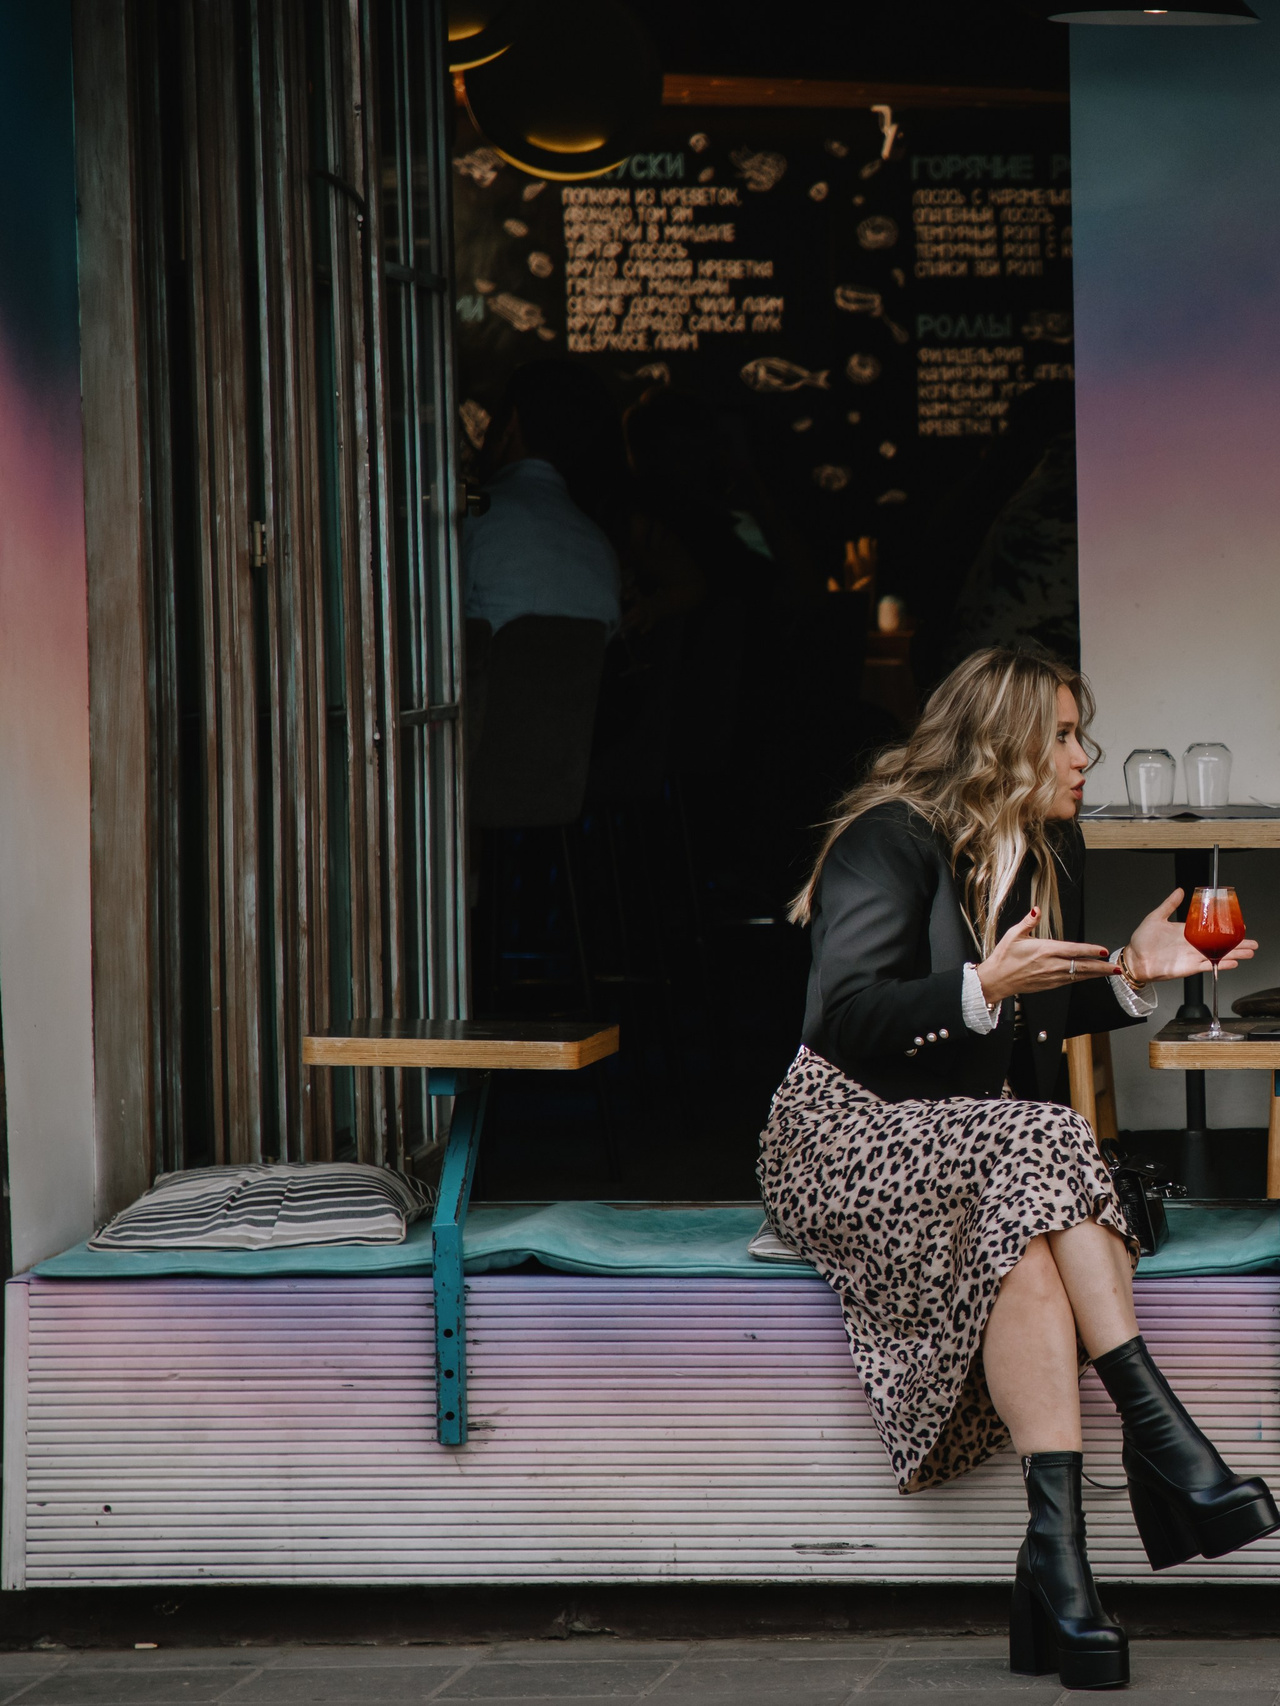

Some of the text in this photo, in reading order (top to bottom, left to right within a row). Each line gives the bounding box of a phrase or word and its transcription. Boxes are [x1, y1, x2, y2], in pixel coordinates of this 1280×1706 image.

[911, 154, 1034, 181] ГОРЯЧИЕ
[561, 186, 630, 205] ПОПКОРН
[635, 187, 656, 205] ИЗ
[971, 188, 983, 206] С
[637, 206, 668, 223] ТОМ
[670, 206, 694, 223] ЯМ
[646, 224, 660, 241] В
[629, 242, 689, 259] ЛОСОСЬ
[697, 260, 774, 279] КРЕВЕТКА
[916, 313, 1013, 339] РОЛЛЫ
[917, 346, 1024, 364] ФИЛАДЕЛЬФИЯ
